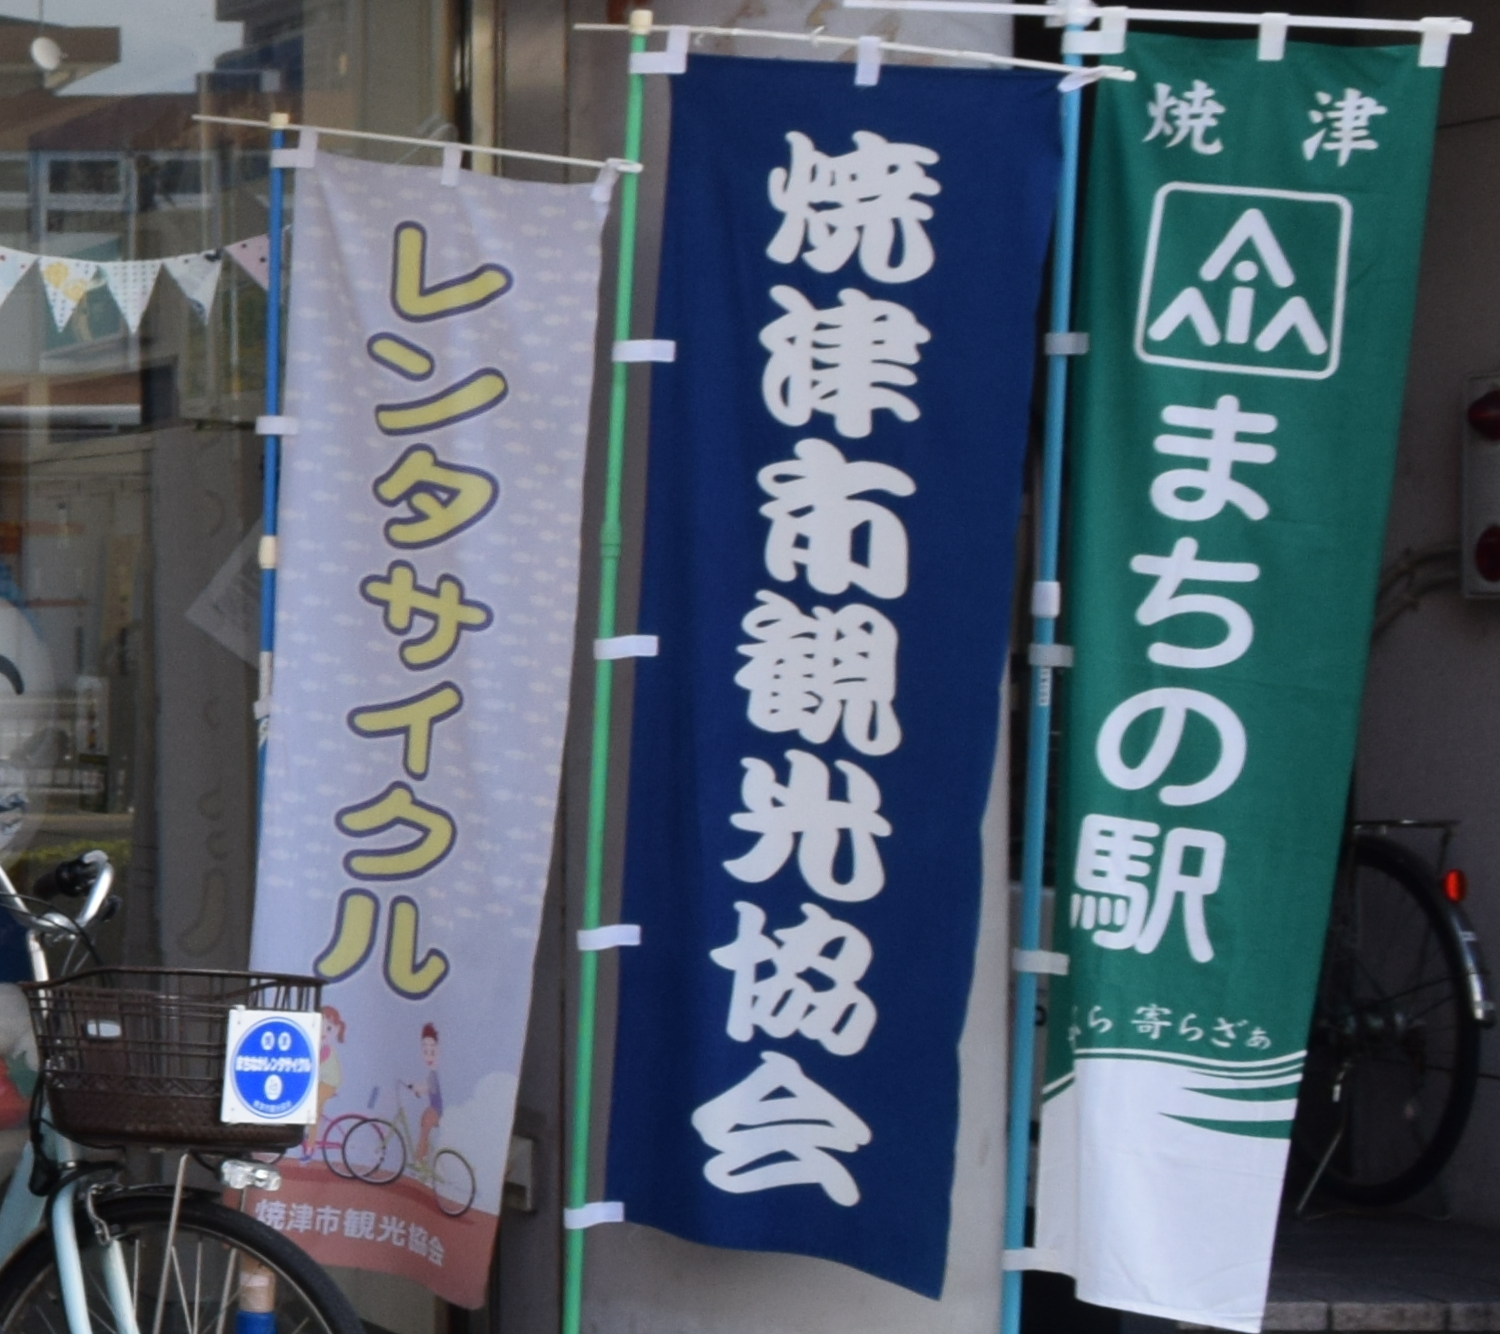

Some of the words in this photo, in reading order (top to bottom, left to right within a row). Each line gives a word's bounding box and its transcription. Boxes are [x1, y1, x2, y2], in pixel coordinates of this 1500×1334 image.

[314, 220, 514, 1001] レンタサイクル
[690, 130, 942, 1207] 焼津市観光協会
[1070, 394, 1280, 963] まちの駅
[255, 1197, 446, 1267] 焼津市観光協会
